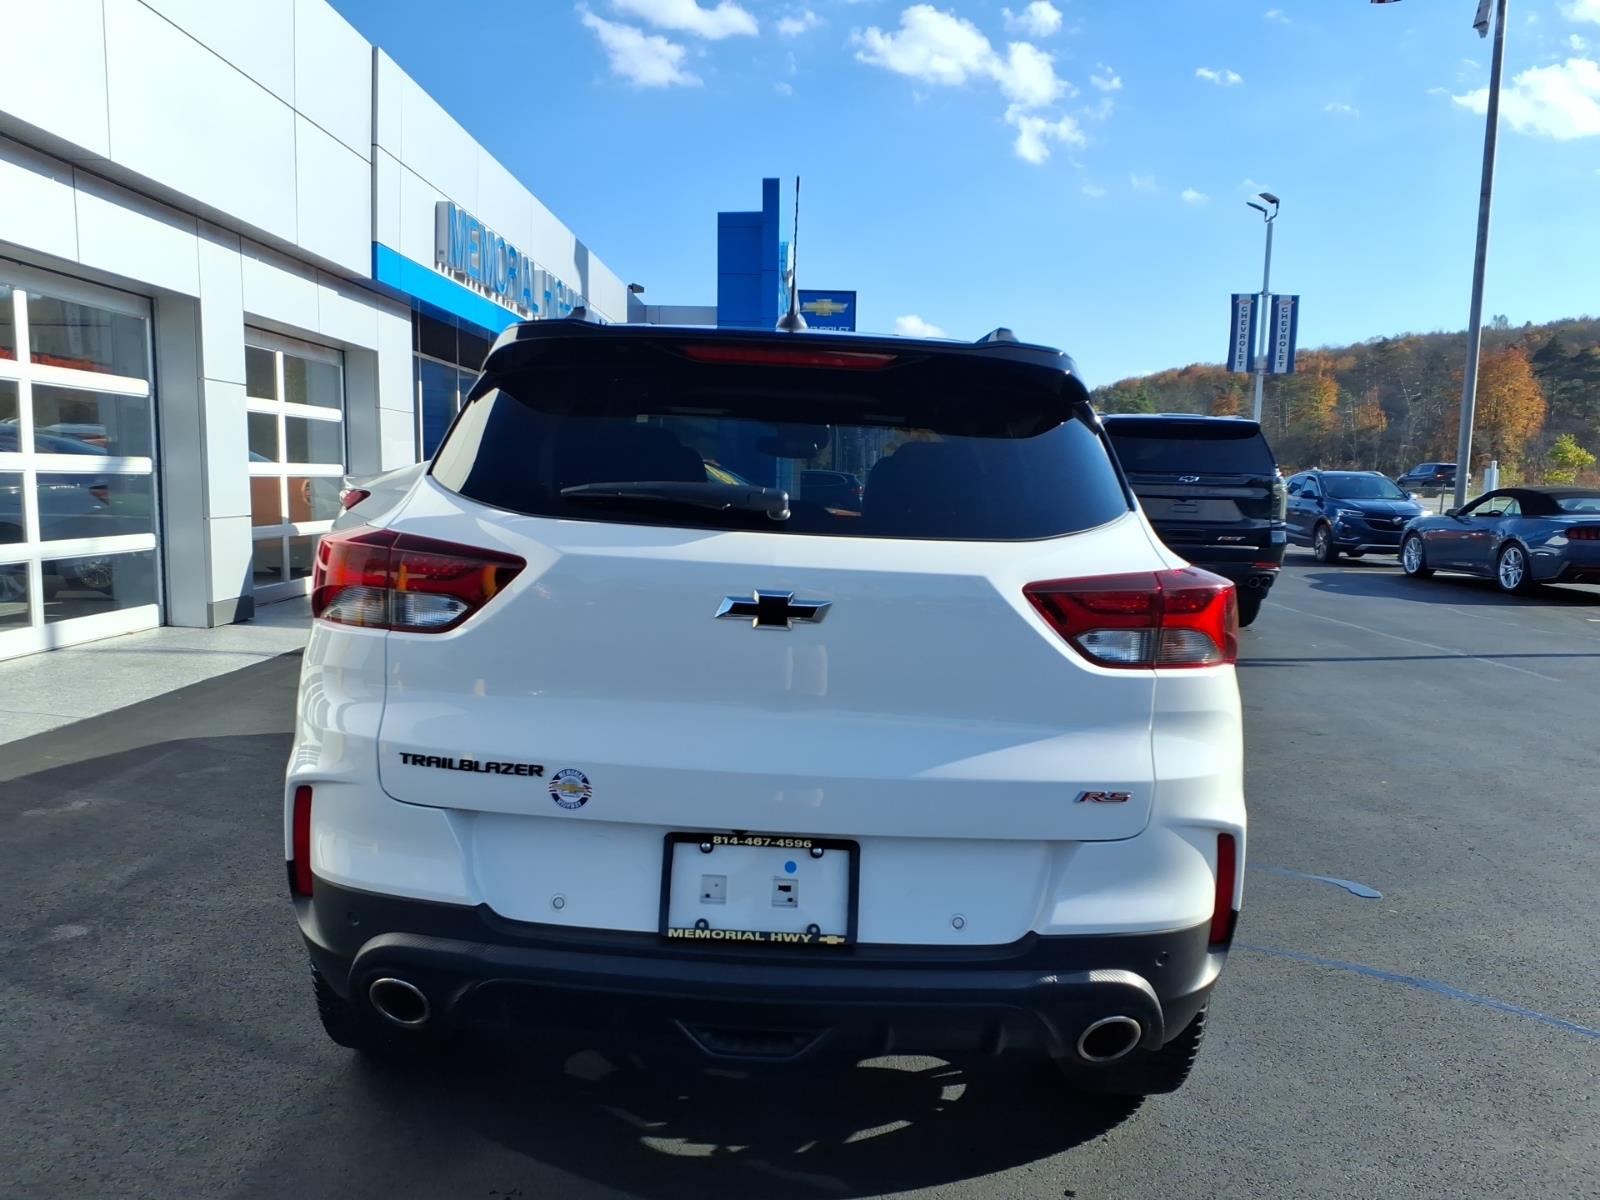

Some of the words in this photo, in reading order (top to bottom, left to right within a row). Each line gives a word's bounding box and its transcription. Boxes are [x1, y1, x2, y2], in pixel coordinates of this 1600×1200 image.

[436, 201, 539, 316] MEMORIAL
[1237, 306, 1248, 367] CHEVROLET
[1277, 307, 1288, 367] CHEVROLET
[400, 752, 544, 777] TRAILBLAZER
[1074, 790, 1133, 804] RS
[712, 835, 812, 848] 814-467-4596
[667, 928, 765, 942] MEMORIAL
[770, 932, 812, 944] HWY
